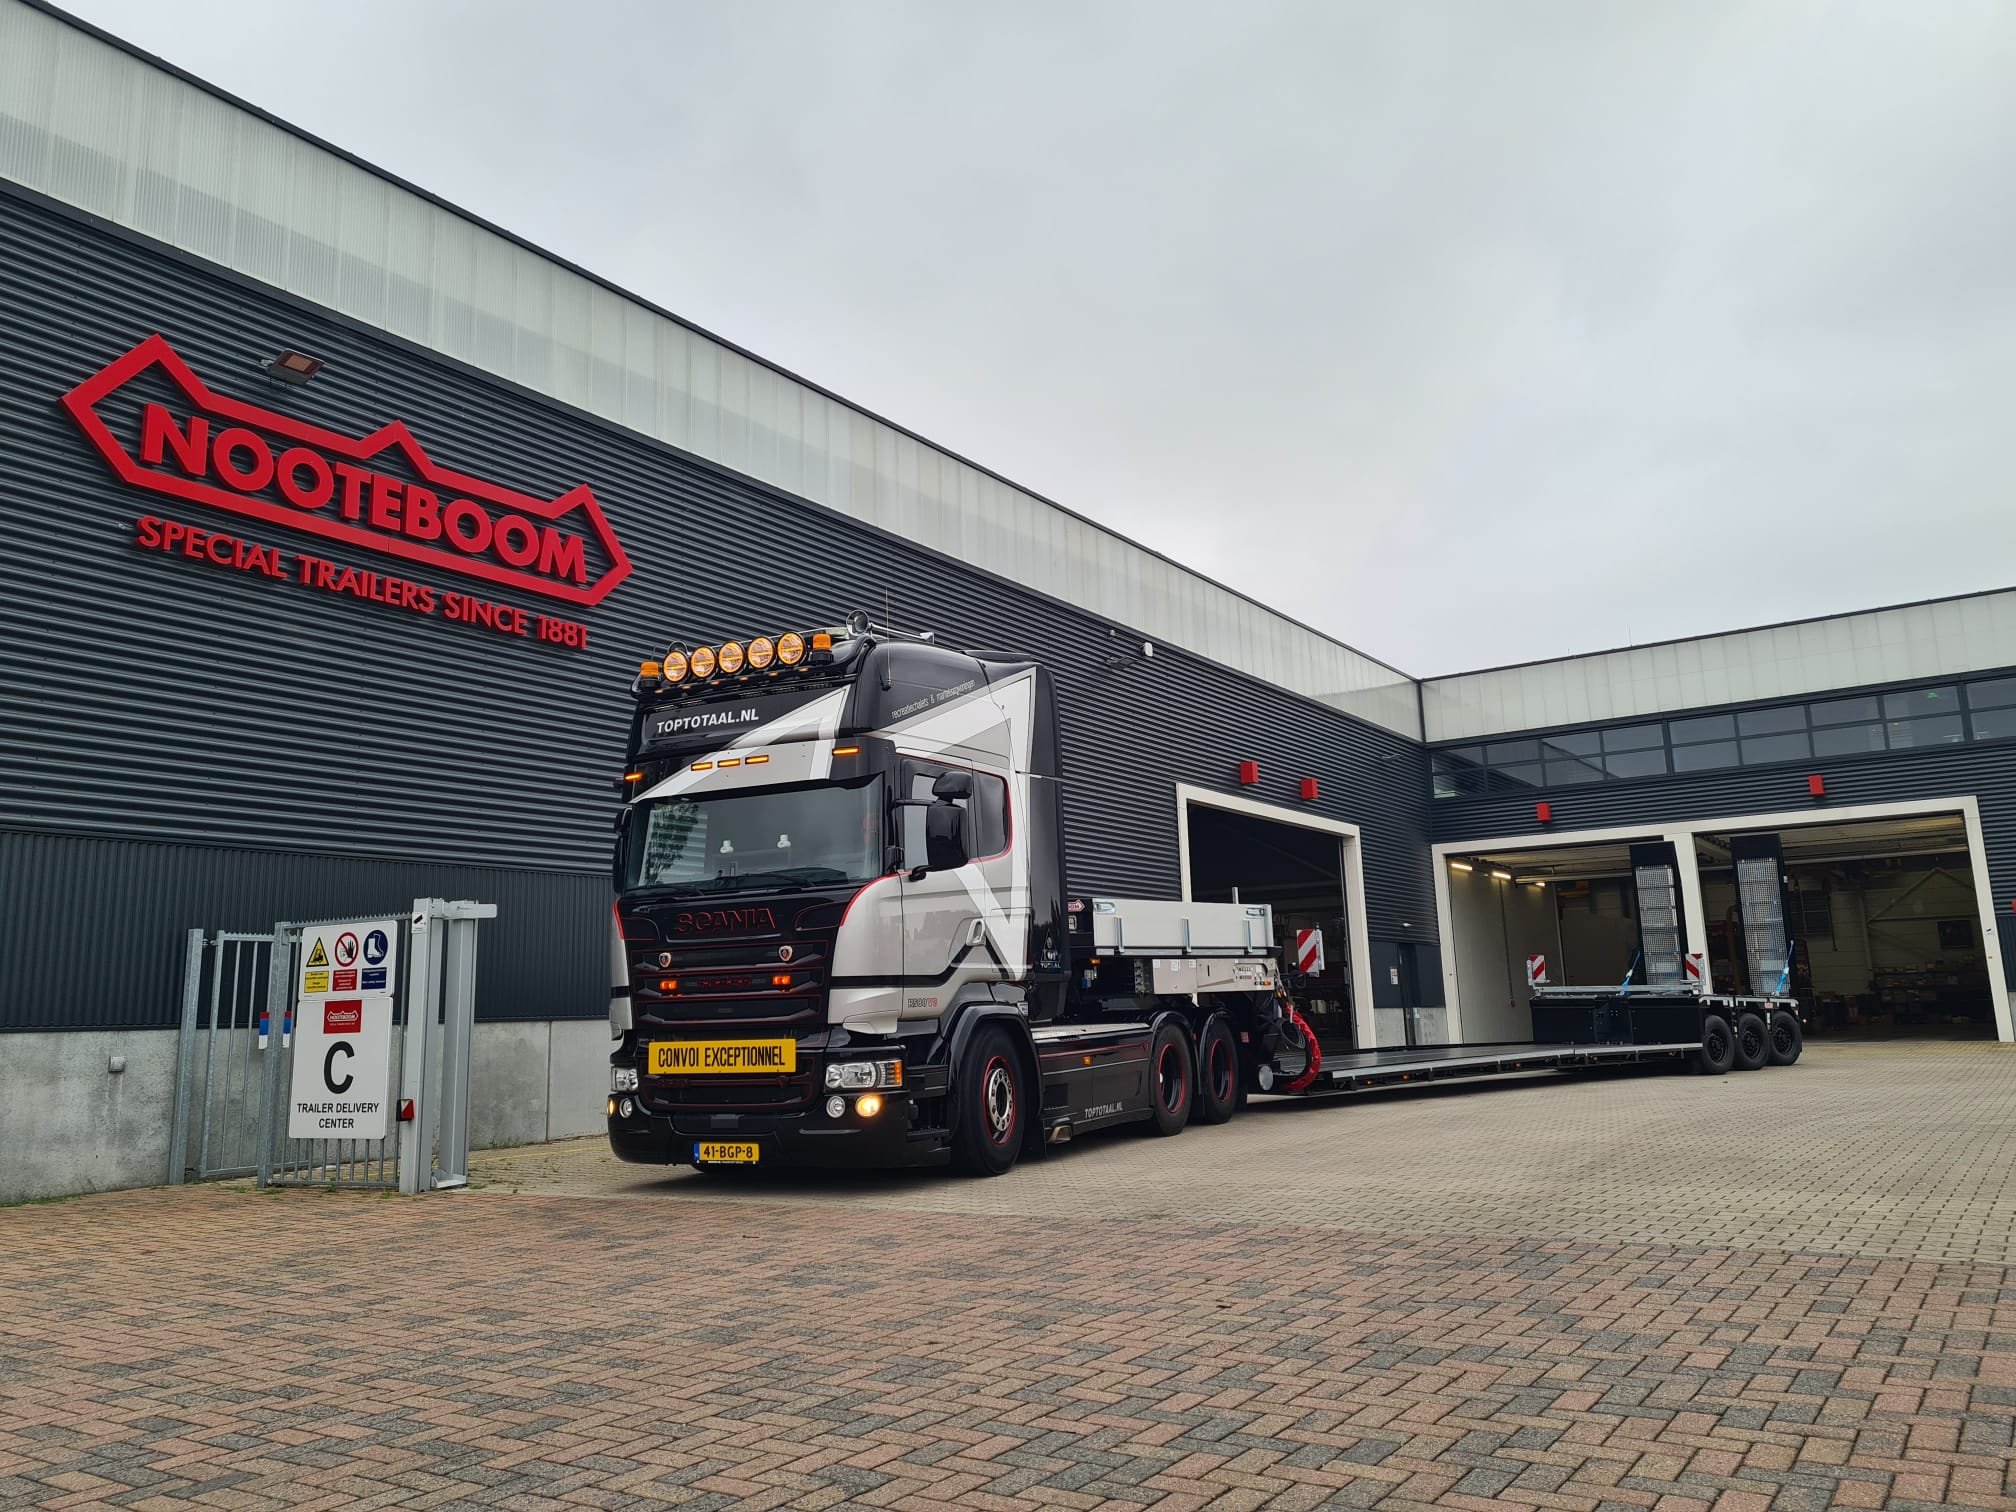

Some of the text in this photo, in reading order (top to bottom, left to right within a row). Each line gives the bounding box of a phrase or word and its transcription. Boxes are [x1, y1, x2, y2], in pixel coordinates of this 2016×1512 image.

[139, 402, 588, 584] NOOTEBOOM
[137, 515, 589, 650] SPECIAL TRAILERS SINCE 1881
[656, 708, 760, 734] TOPTOTAAL.NL
[676, 907, 776, 934] SCANIA
[323, 1040, 355, 1095] C
[658, 1046, 786, 1068] CONVOI EXCEPTIONNEL
[296, 1102, 380, 1114] TRAILER DELIVERY
[318, 1117, 355, 1129] CENTER
[703, 1145, 753, 1159] 41-BGP-8
